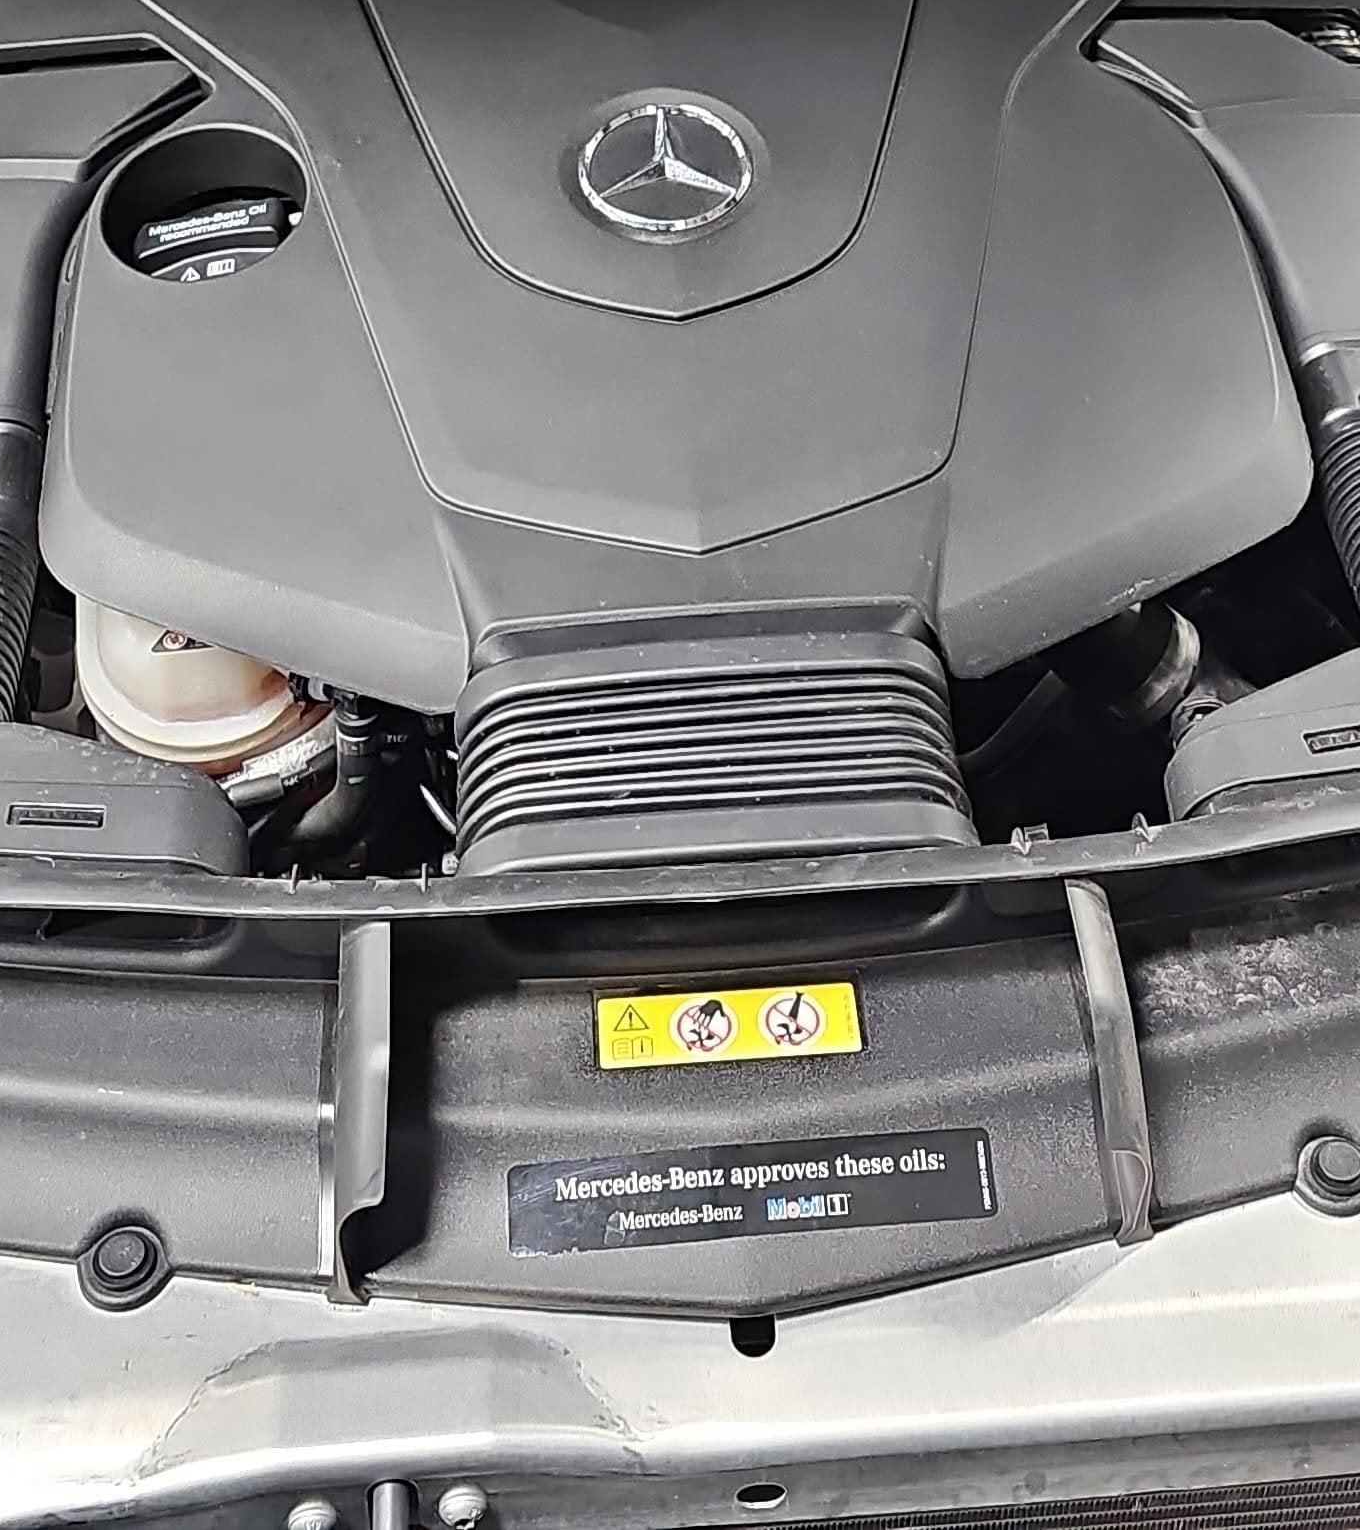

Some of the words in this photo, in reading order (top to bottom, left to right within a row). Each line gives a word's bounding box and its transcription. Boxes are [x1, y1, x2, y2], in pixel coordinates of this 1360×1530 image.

[148, 209, 249, 237] Mercedes-Benz
[248, 202, 267, 215] Oil
[159, 216, 250, 243] recommended
[555, 1166, 725, 1201] Mercedes-Benz
[730, 1160, 830, 1189] approves
[834, 1153, 894, 1177] these
[899, 1148, 946, 1172] oils:
[619, 1204, 744, 1231] Mercedes-Benz
[766, 1194, 827, 1220] Mobil
